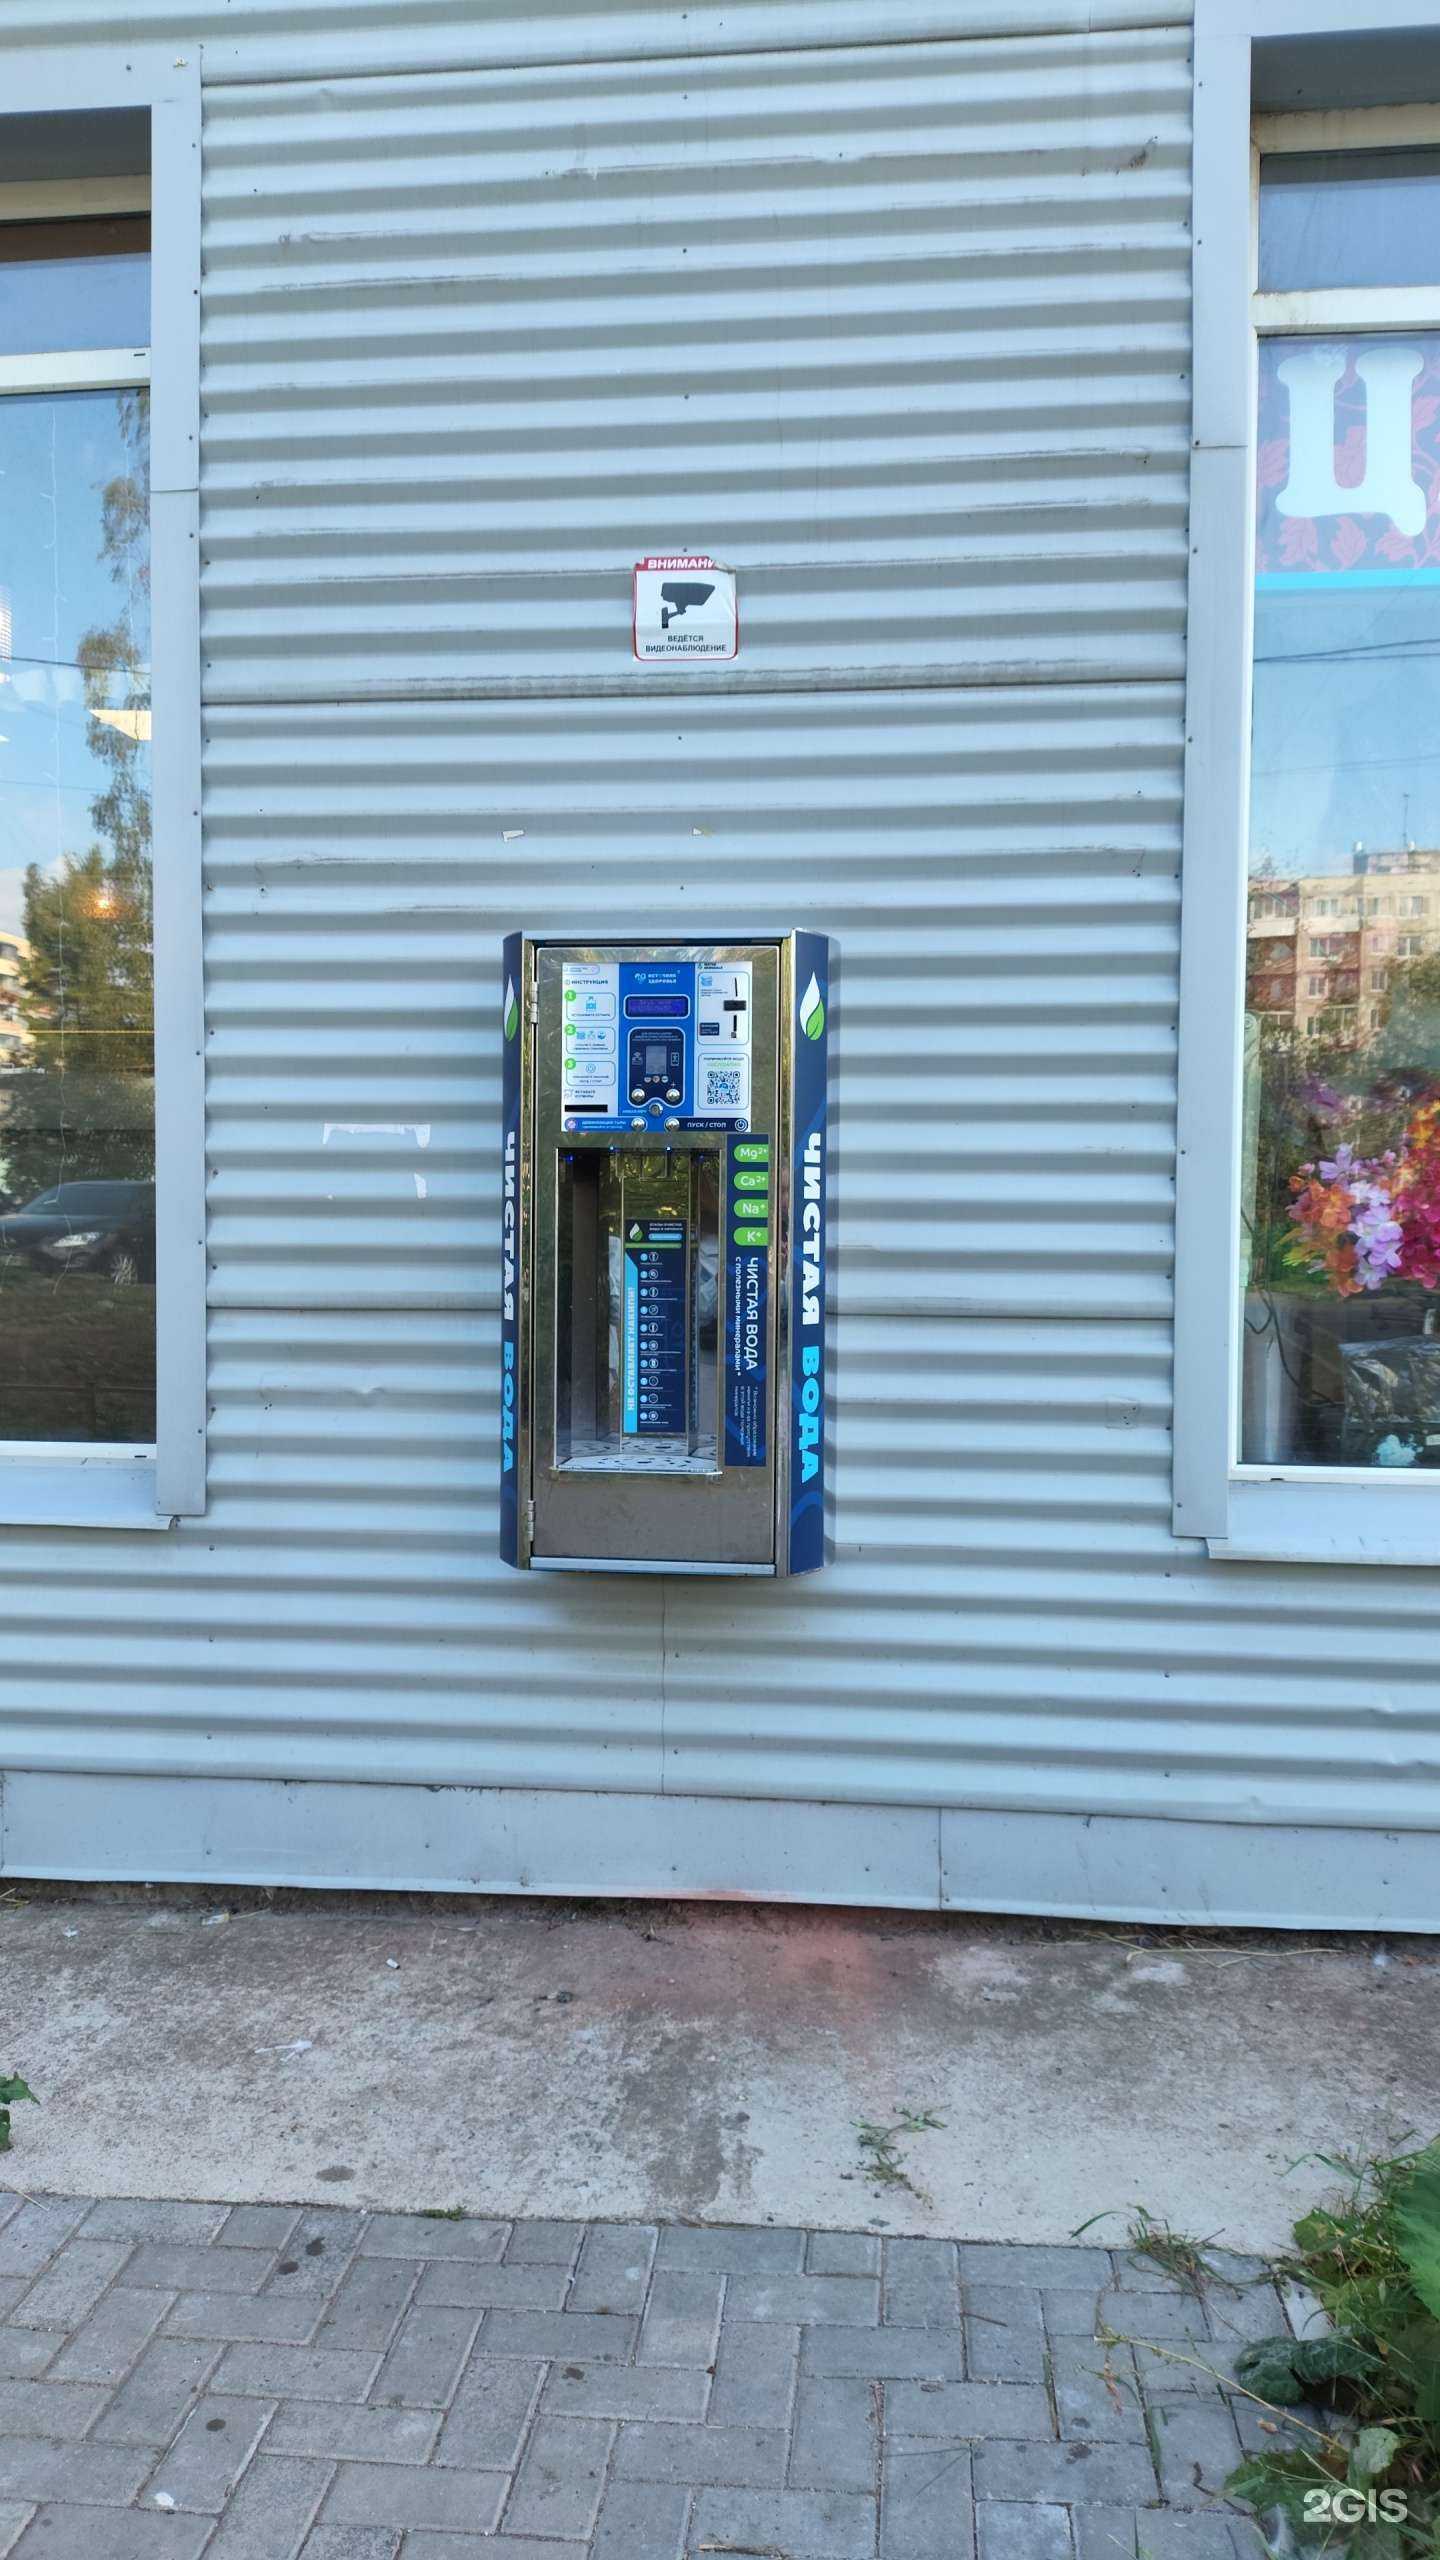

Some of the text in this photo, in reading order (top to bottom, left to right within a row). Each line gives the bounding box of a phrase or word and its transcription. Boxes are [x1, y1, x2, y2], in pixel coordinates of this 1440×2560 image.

[1275, 349, 1440, 536] Ц
[645, 643, 728, 653] ВИДЕОНАБЛЮДЕНИЕ
[667, 634, 704, 643] ВЕДЁТСЯ
[503, 1131, 515, 1473] ЧИСТАЯ ВОДА
[743, 1257, 758, 1370] ЧИСТАЯ ВОДА
[799, 1132, 821, 1484] ЧИСТАЯ ВОДА
